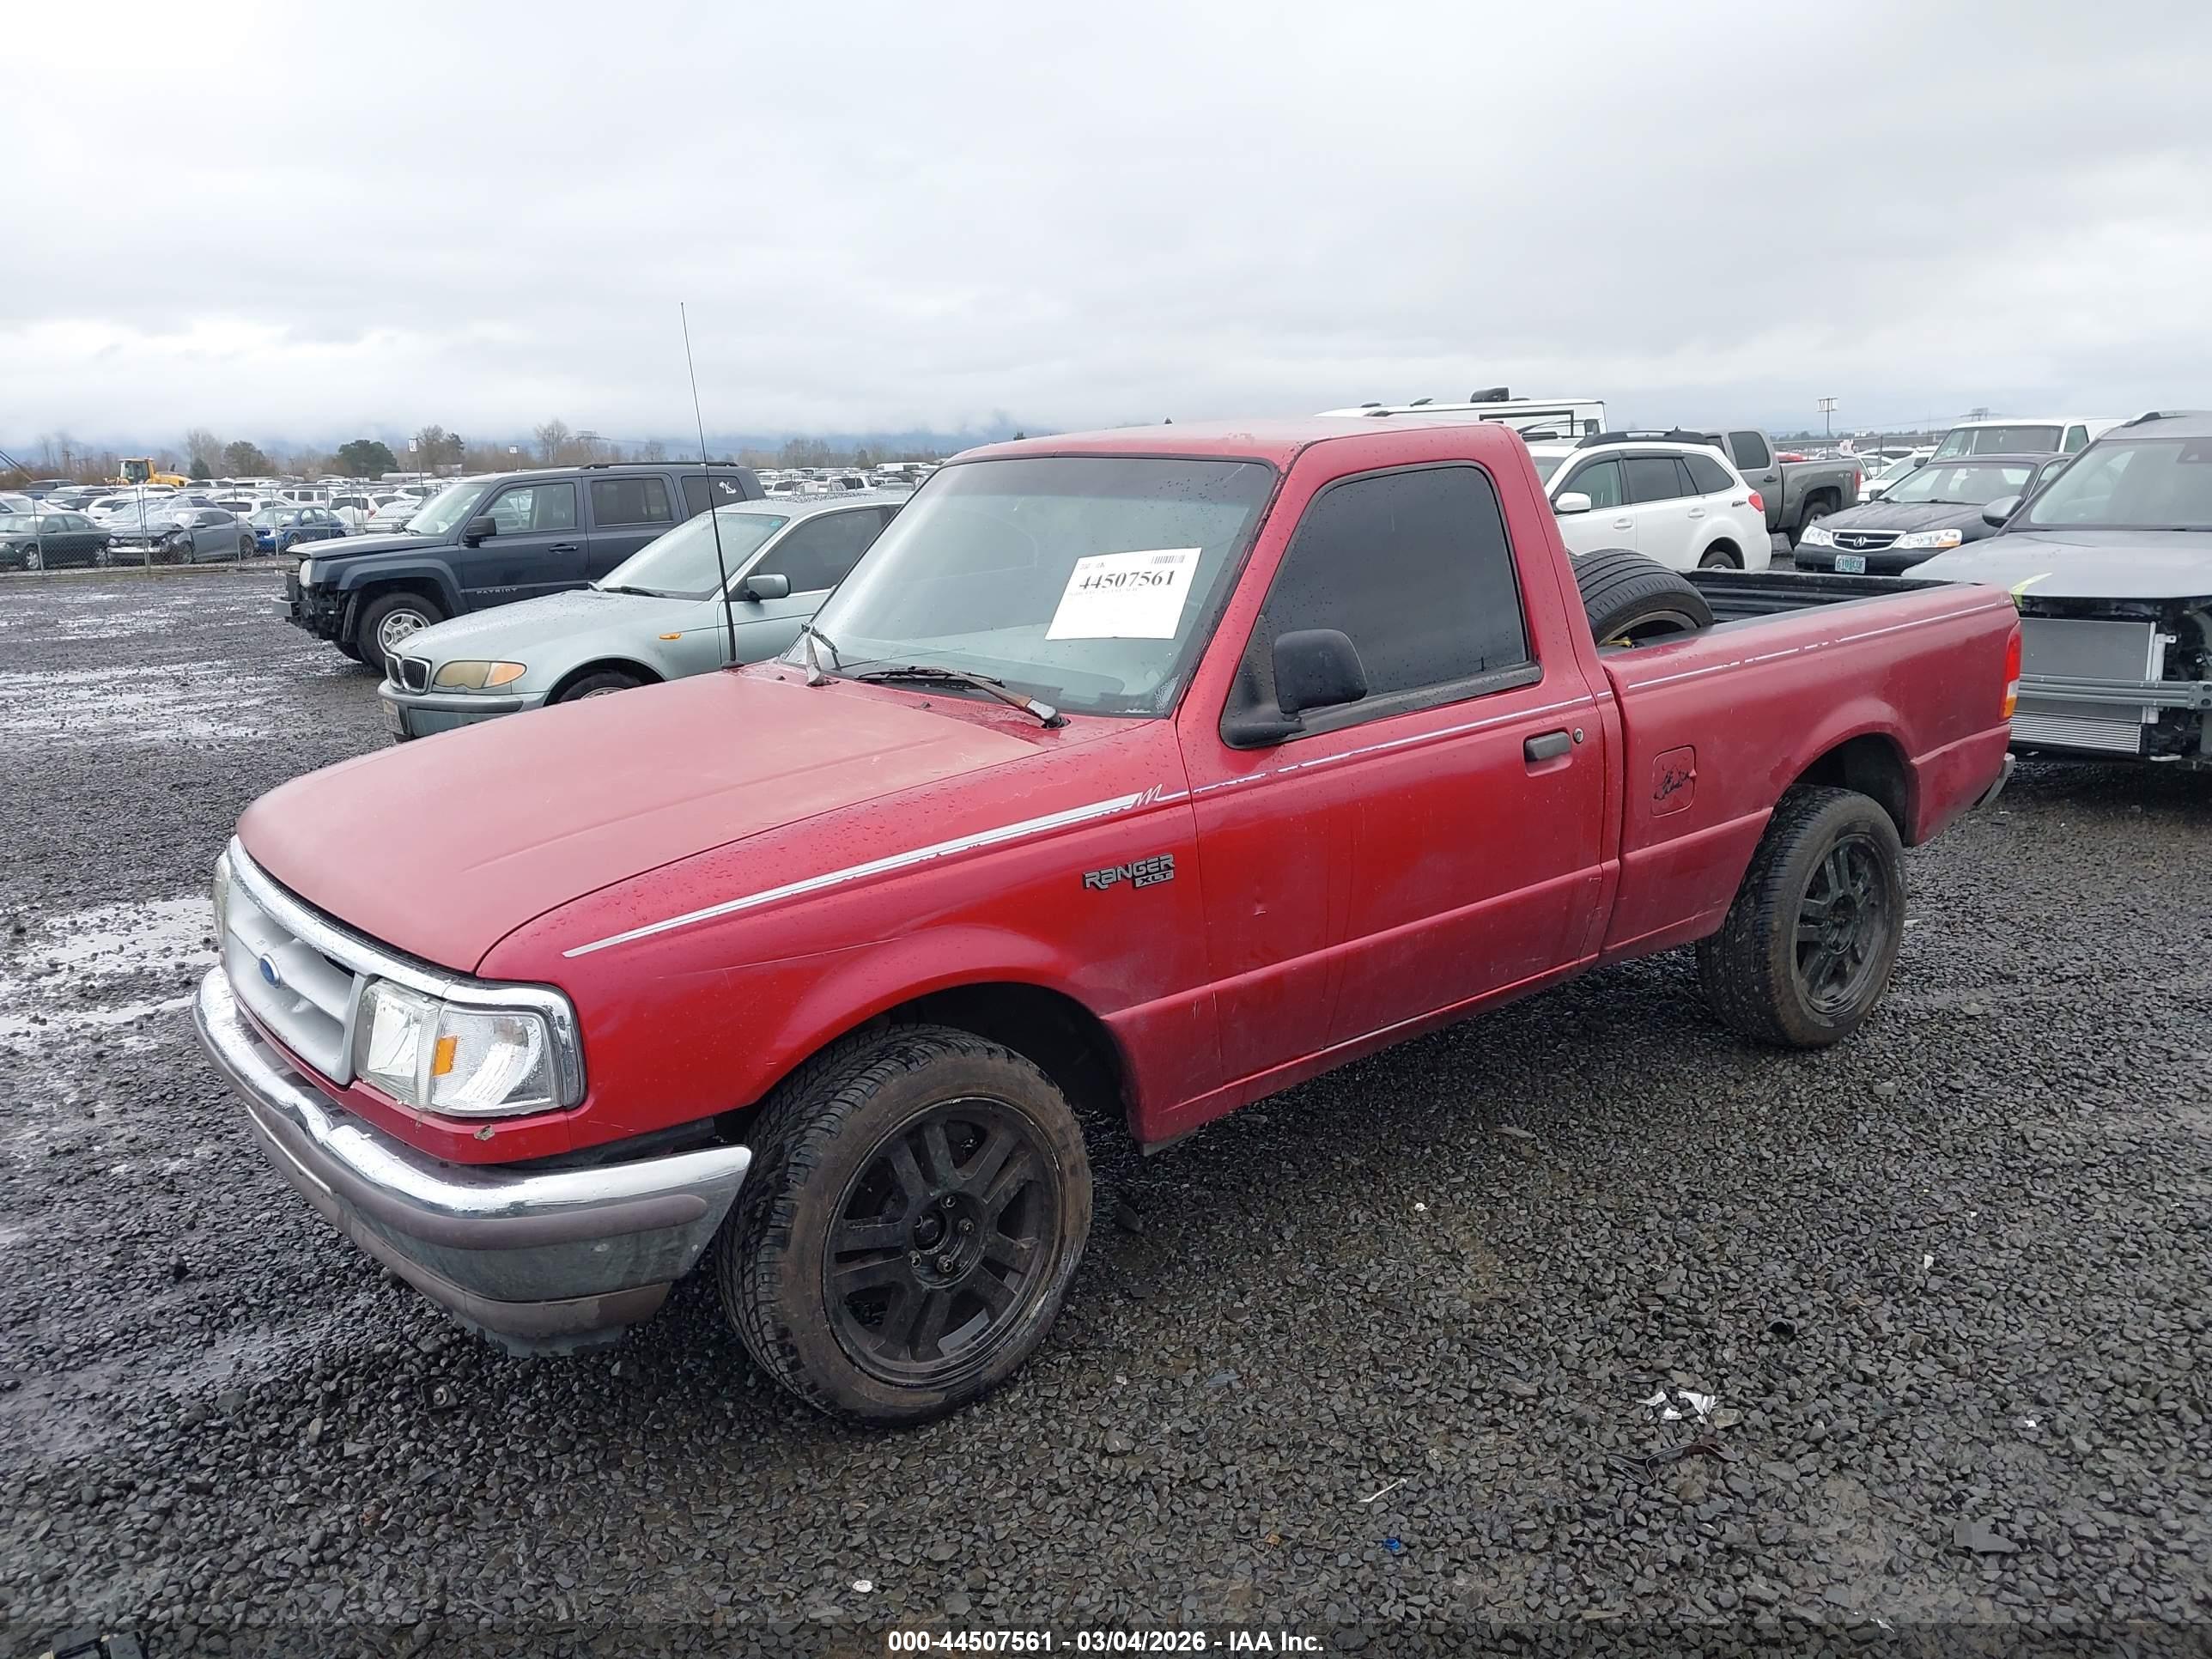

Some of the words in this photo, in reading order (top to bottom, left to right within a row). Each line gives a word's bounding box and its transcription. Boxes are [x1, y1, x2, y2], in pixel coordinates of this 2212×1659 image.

[1079, 570, 1175, 590] 44507561
[1083, 853, 1176, 890] RANGER
[1138, 870, 1171, 886] XLT
